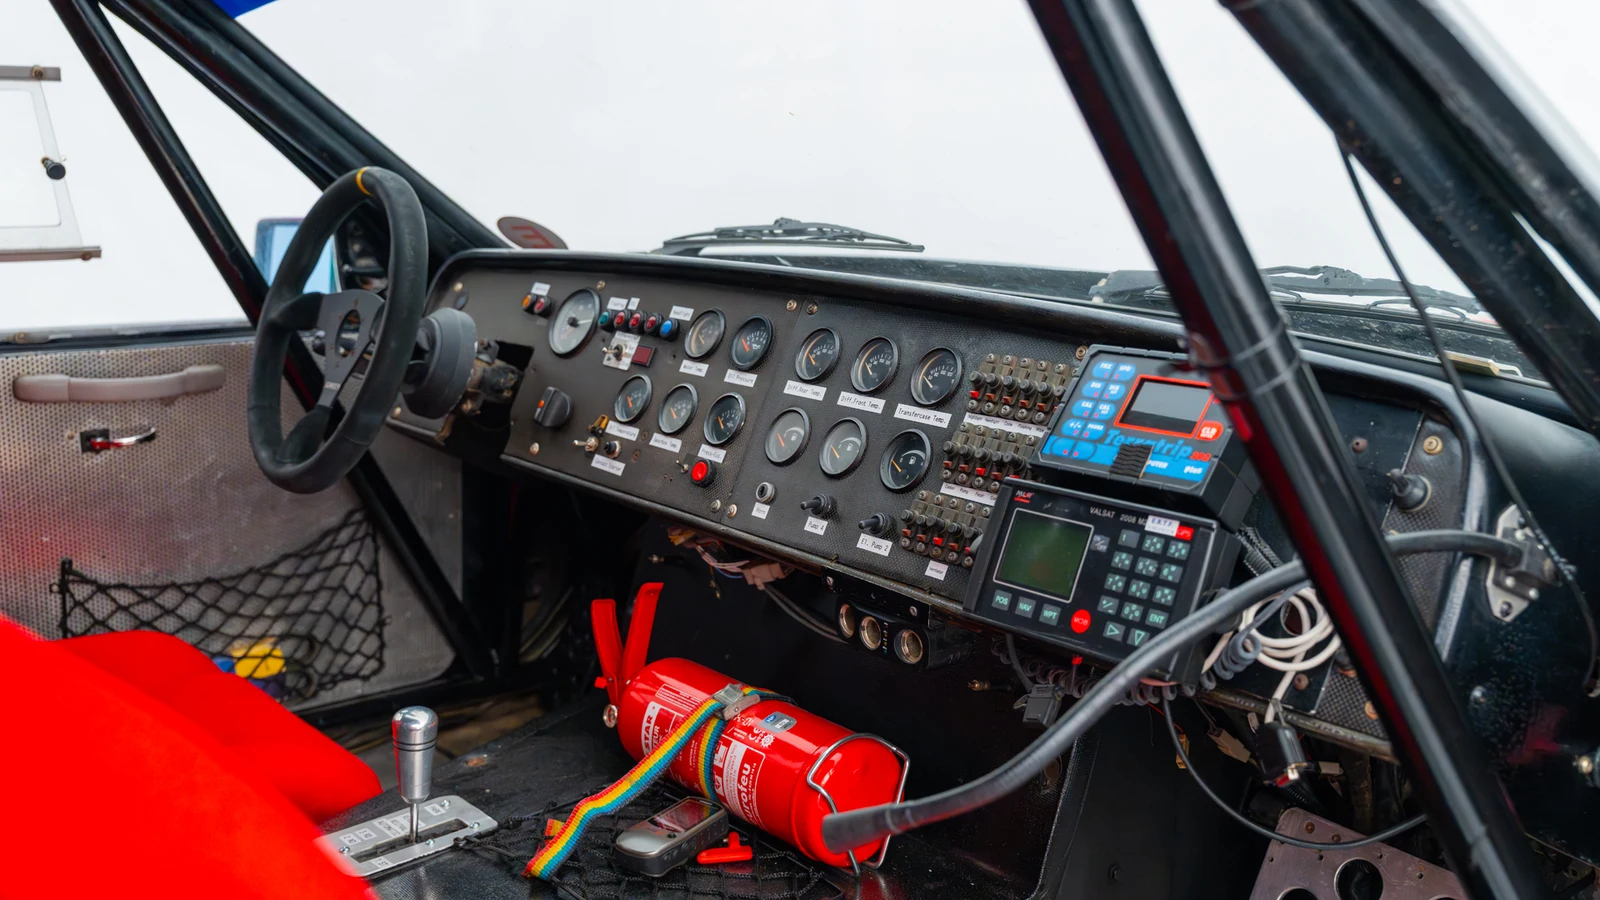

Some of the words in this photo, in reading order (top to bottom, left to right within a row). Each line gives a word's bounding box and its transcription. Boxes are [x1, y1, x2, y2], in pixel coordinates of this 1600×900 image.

[898, 407, 931, 421] Transfercase
[933, 414, 946, 424] Temp.
[1089, 506, 1116, 519] VALSAT
[1120, 513, 1137, 524] 2008
[807, 521, 820, 530] Pump
[870, 541, 883, 551] Pump
[995, 595, 1009, 606] POS
[1019, 602, 1032, 612] NAV
[1043, 610, 1058, 620] WPT
[1149, 613, 1165, 624] ENT
[1073, 617, 1088, 626] MOB
[738, 763, 752, 822] urofeu
